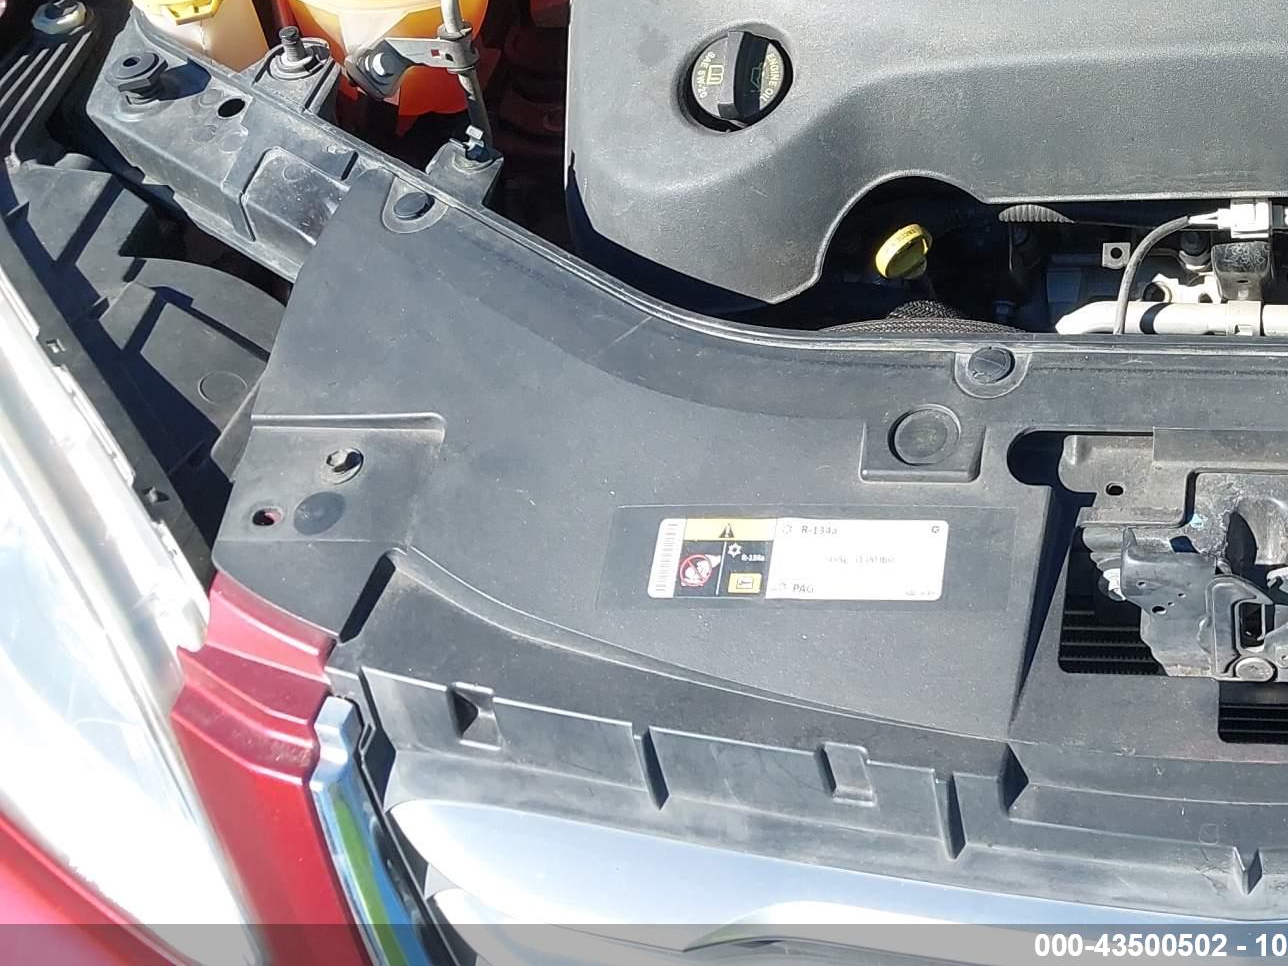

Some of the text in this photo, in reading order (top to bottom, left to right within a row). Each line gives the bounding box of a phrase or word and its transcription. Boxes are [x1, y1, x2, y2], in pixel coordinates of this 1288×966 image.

[696, 51, 716, 99] SAE 5W-20
[759, 53, 780, 102] ENGINE OIL
